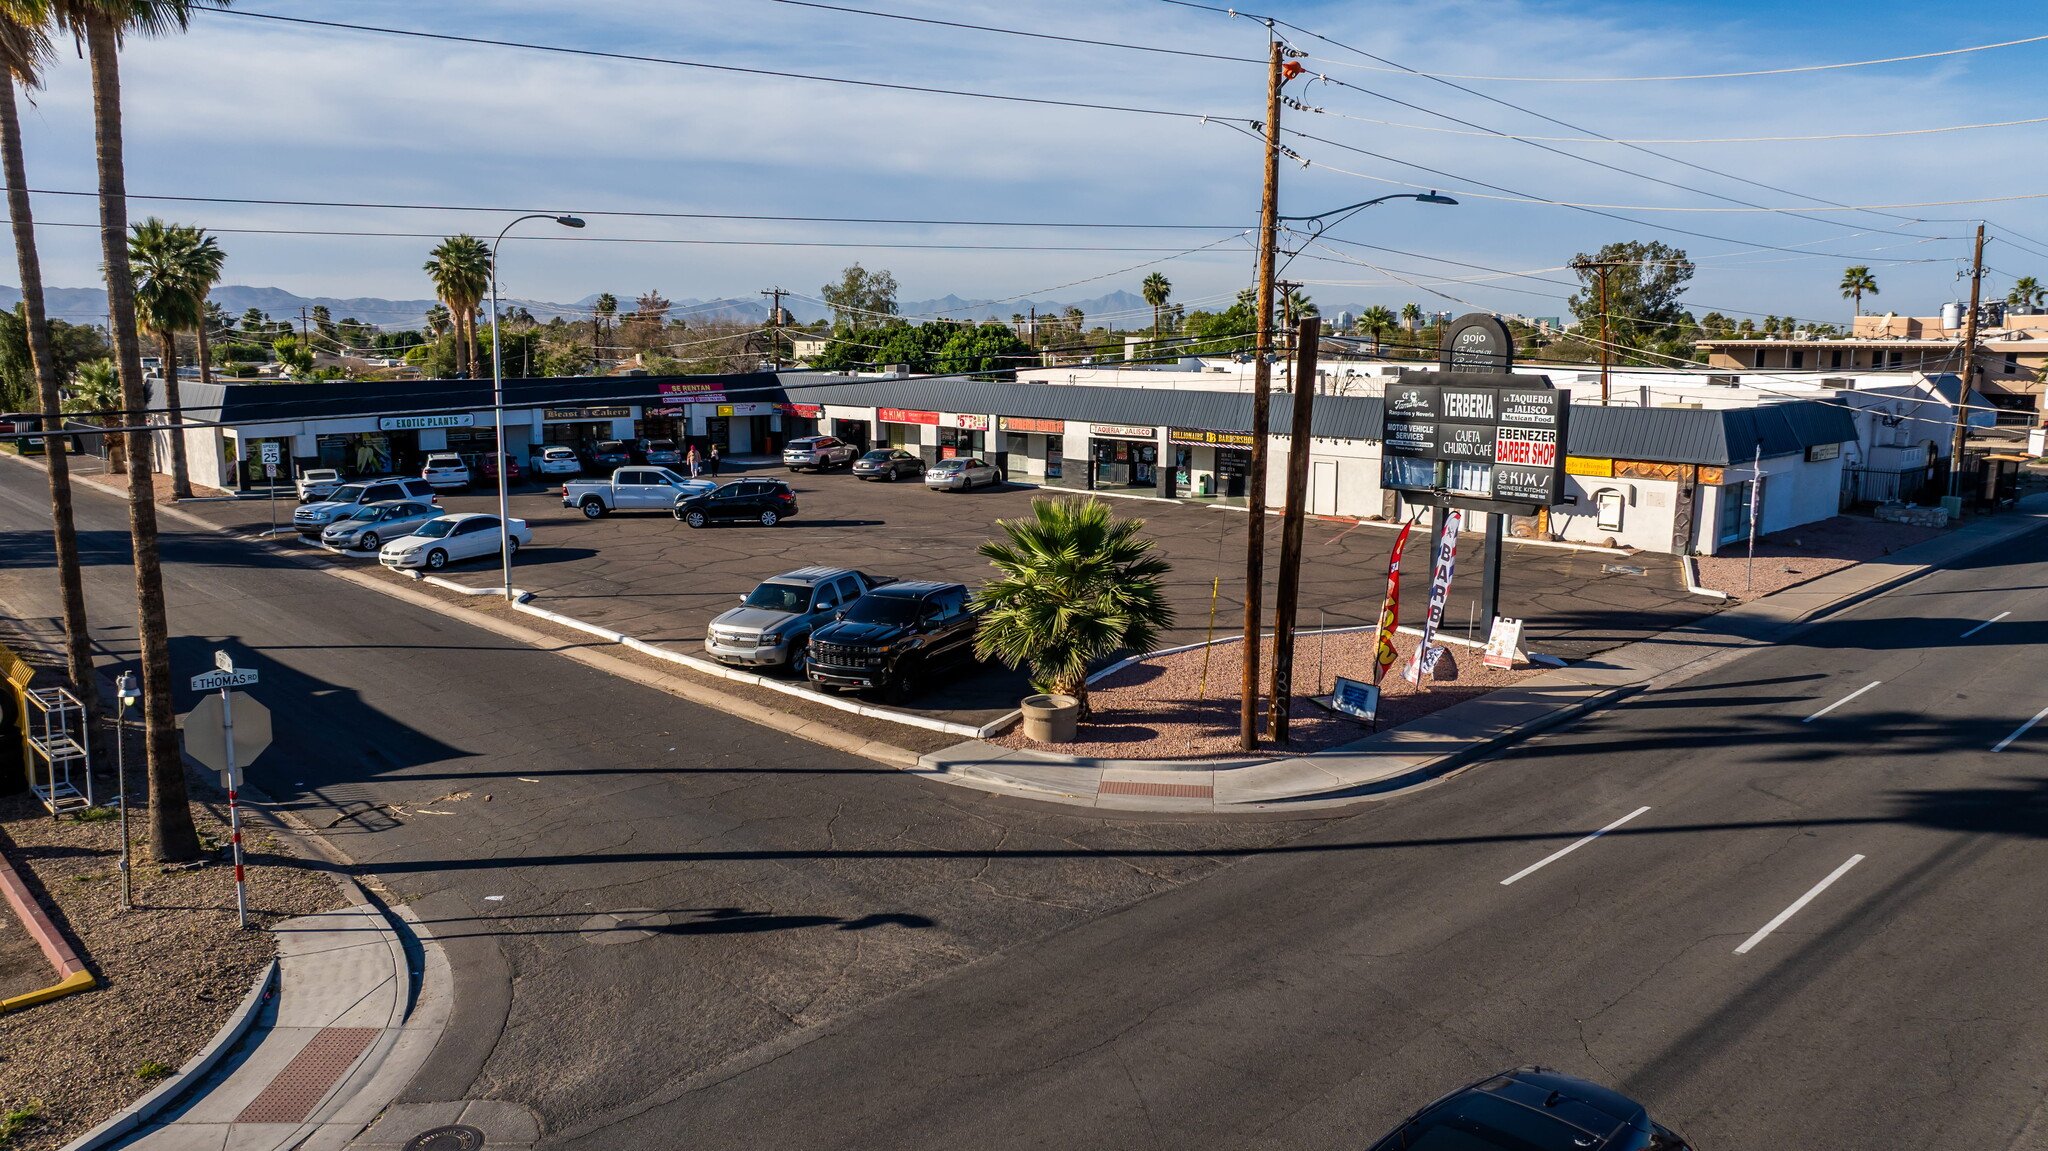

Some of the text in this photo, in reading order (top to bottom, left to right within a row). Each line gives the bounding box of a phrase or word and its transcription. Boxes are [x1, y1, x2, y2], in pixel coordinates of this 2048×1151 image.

[1463, 332, 1486, 344] gojo
[1510, 394, 1553, 404] TAQUERIA
[1443, 393, 1494, 418] YERBERIA
[1514, 405, 1548, 414] JALISCO
[396, 417, 458, 428] EXOTIC PLANTS
[1409, 425, 1434, 434] VEHICLE
[1498, 428, 1556, 442] EBENEZER
[1173, 431, 1204, 440] BILLIONAIRE
[1218, 435, 1253, 444] BARBERSHO
[1396, 432, 1424, 440] SERVICES
[1455, 430, 1480, 443] CAJETA
[1443, 441, 1492, 456] CHURRO CAFÉ
[1497, 441, 1555, 465] BARBER SHOP
[264, 453, 278, 462] 25
[200, 674, 246, 688] THOMAS
